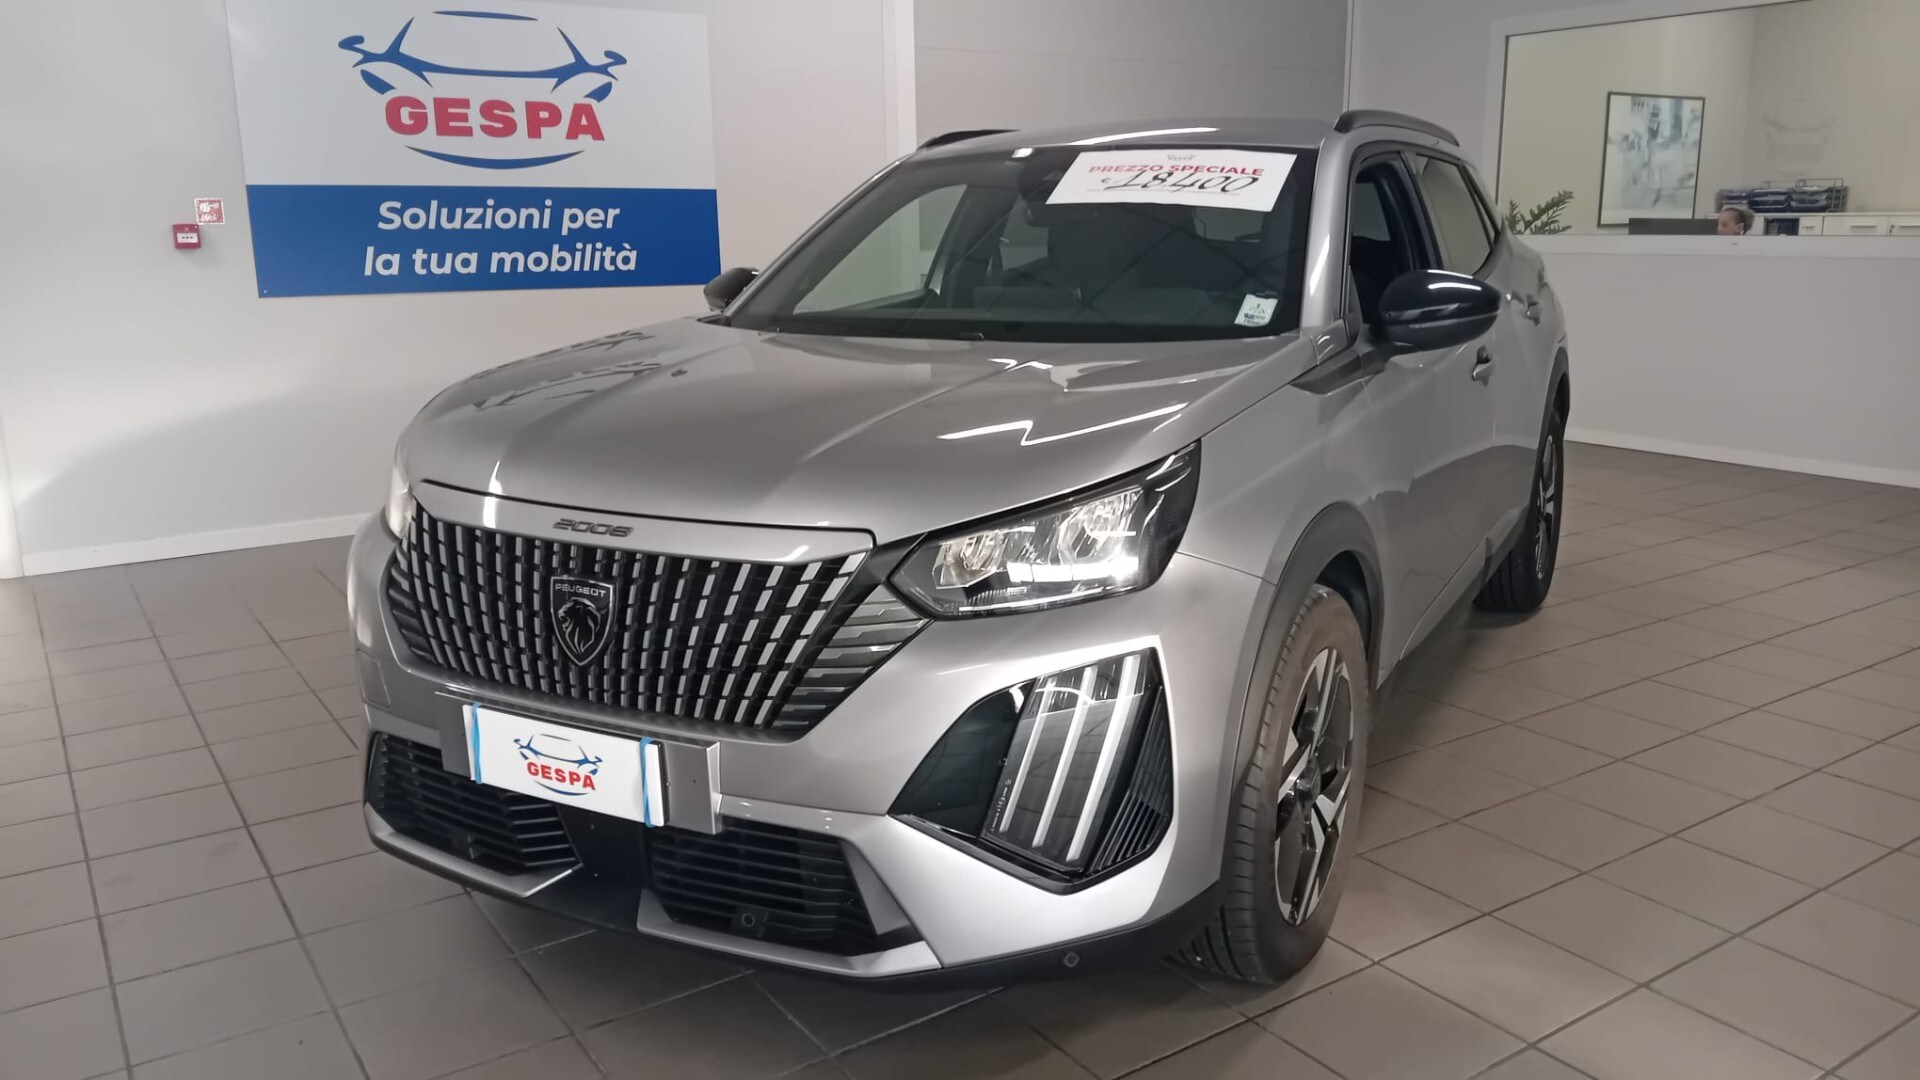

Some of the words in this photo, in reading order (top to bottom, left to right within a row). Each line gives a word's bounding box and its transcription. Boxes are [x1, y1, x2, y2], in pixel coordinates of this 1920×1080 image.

[385, 95, 605, 141] GESPA
[1088, 164, 1164, 173] PREZZO
[1170, 164, 1265, 177] SPECIALE
[377, 198, 552, 231] Soluzioni
[561, 207, 620, 236] per
[364, 246, 400, 276] la
[412, 248, 478, 275] tua
[489, 242, 638, 273] mobilità
[553, 518, 634, 538] 2008
[555, 583, 606, 598] PEUGEOT
[526, 761, 596, 791] GESPA
